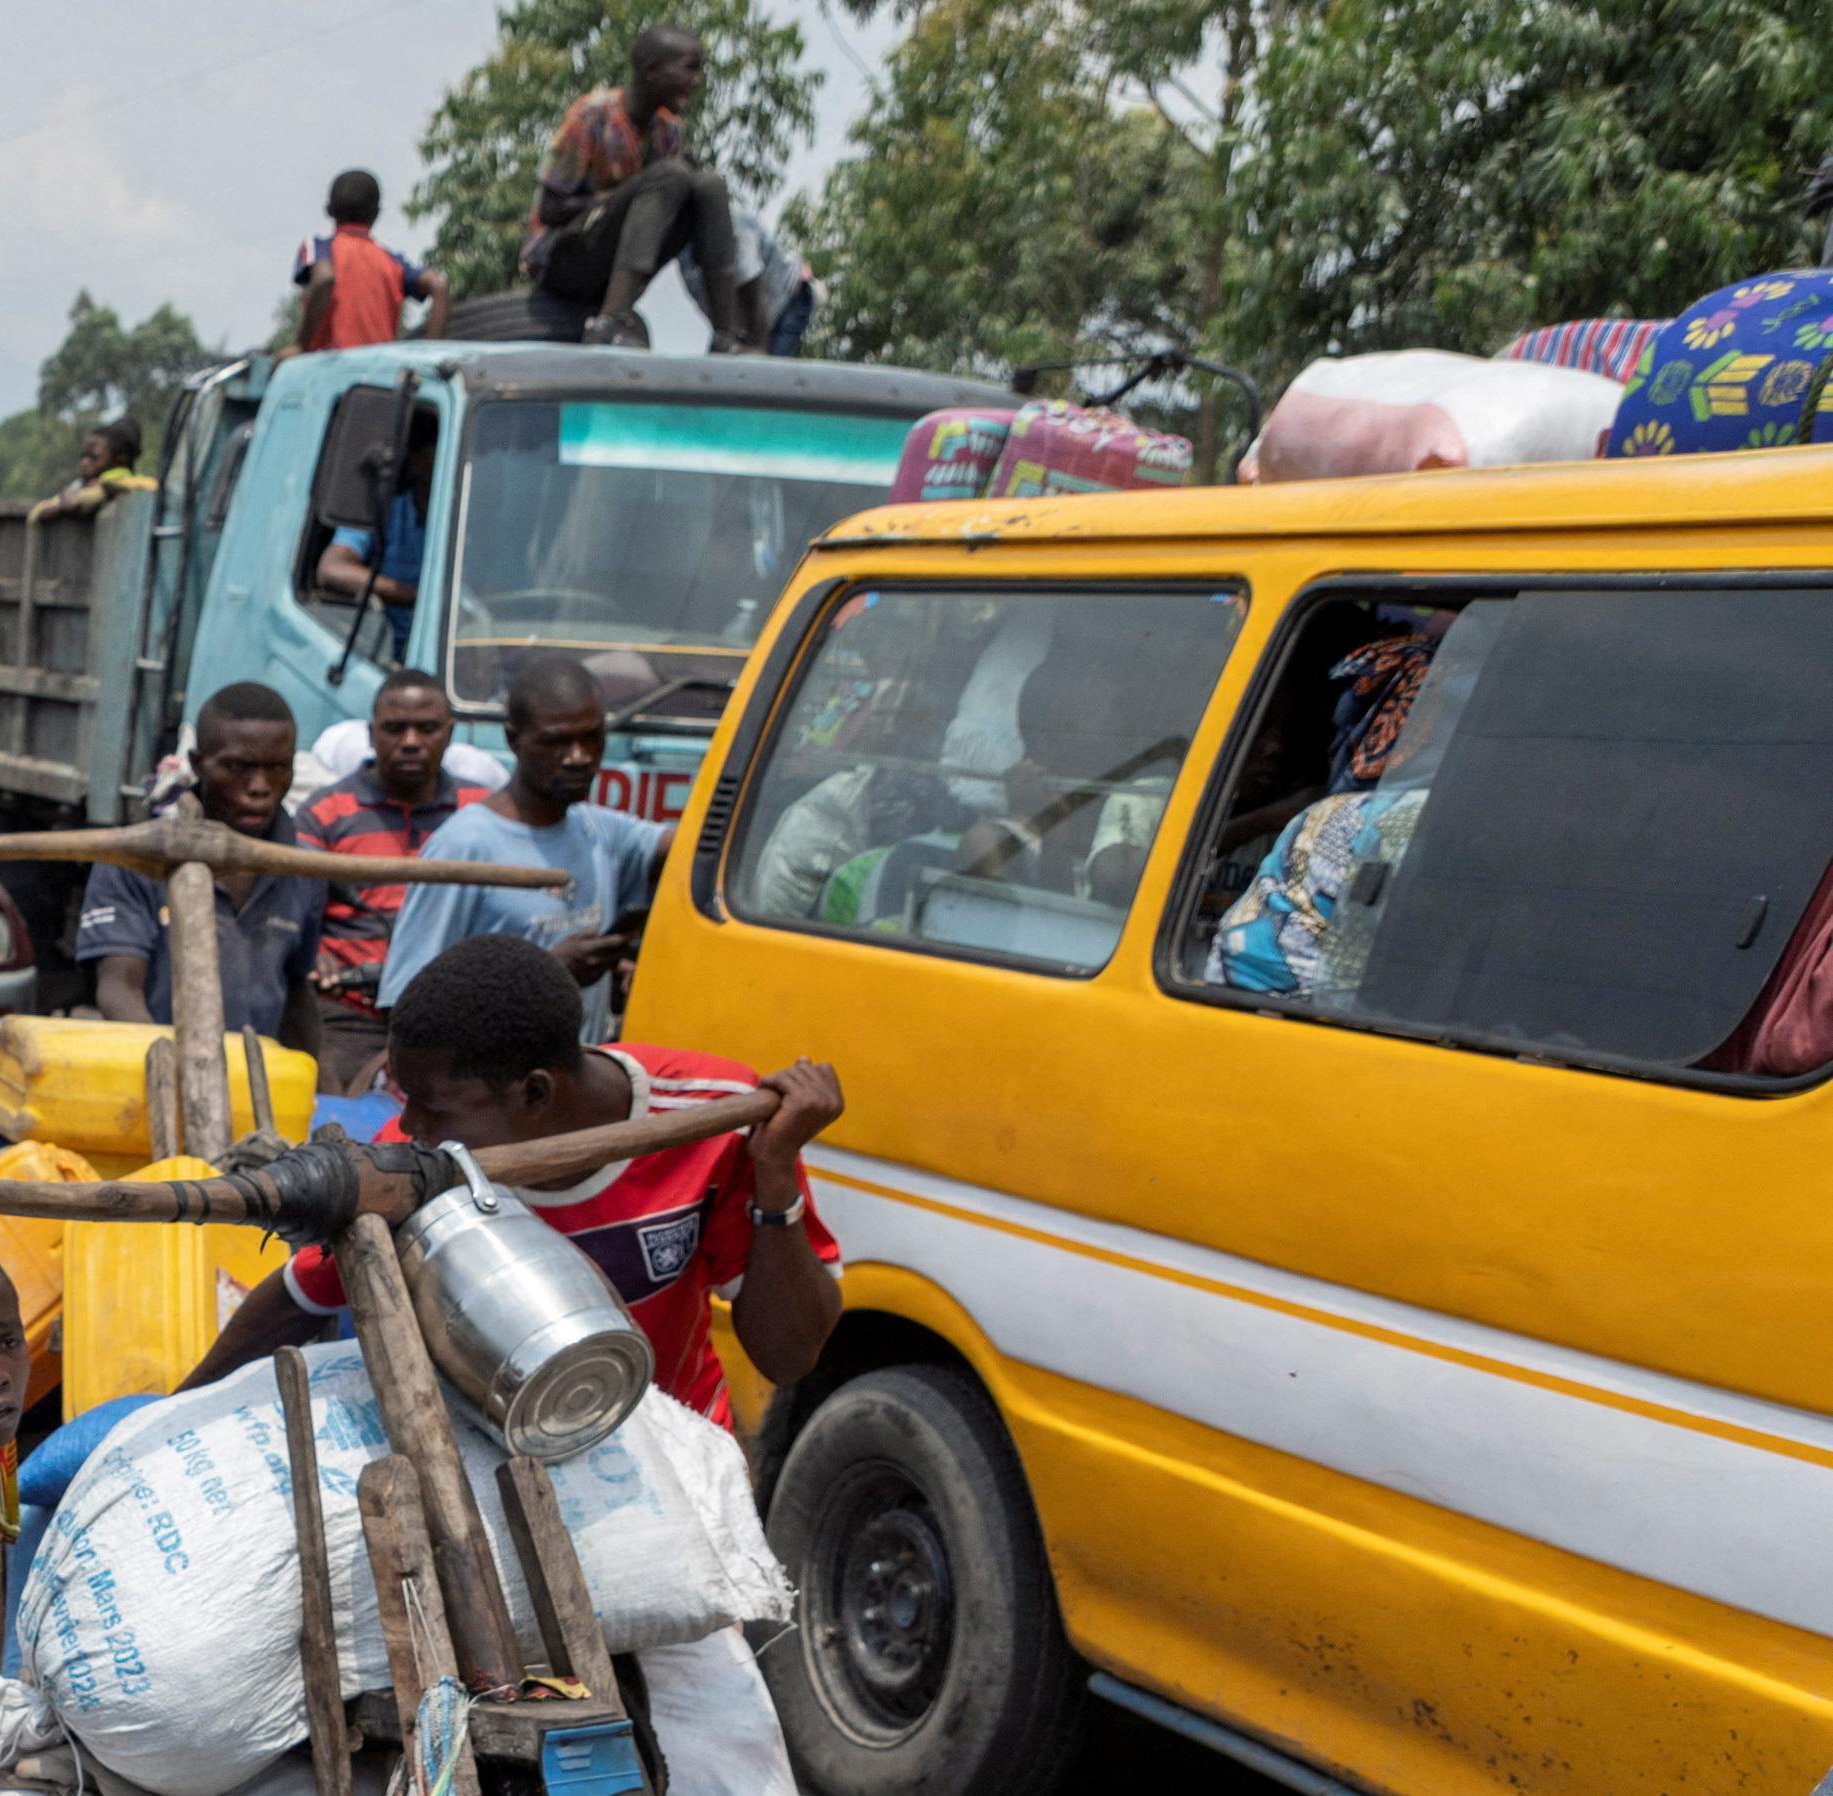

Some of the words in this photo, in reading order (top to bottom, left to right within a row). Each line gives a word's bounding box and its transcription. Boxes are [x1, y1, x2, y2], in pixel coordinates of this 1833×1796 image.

[147, 1510, 190, 1575] RDC
[87, 1569, 122, 1630] Mars
[105, 1632, 150, 1695] 2023
